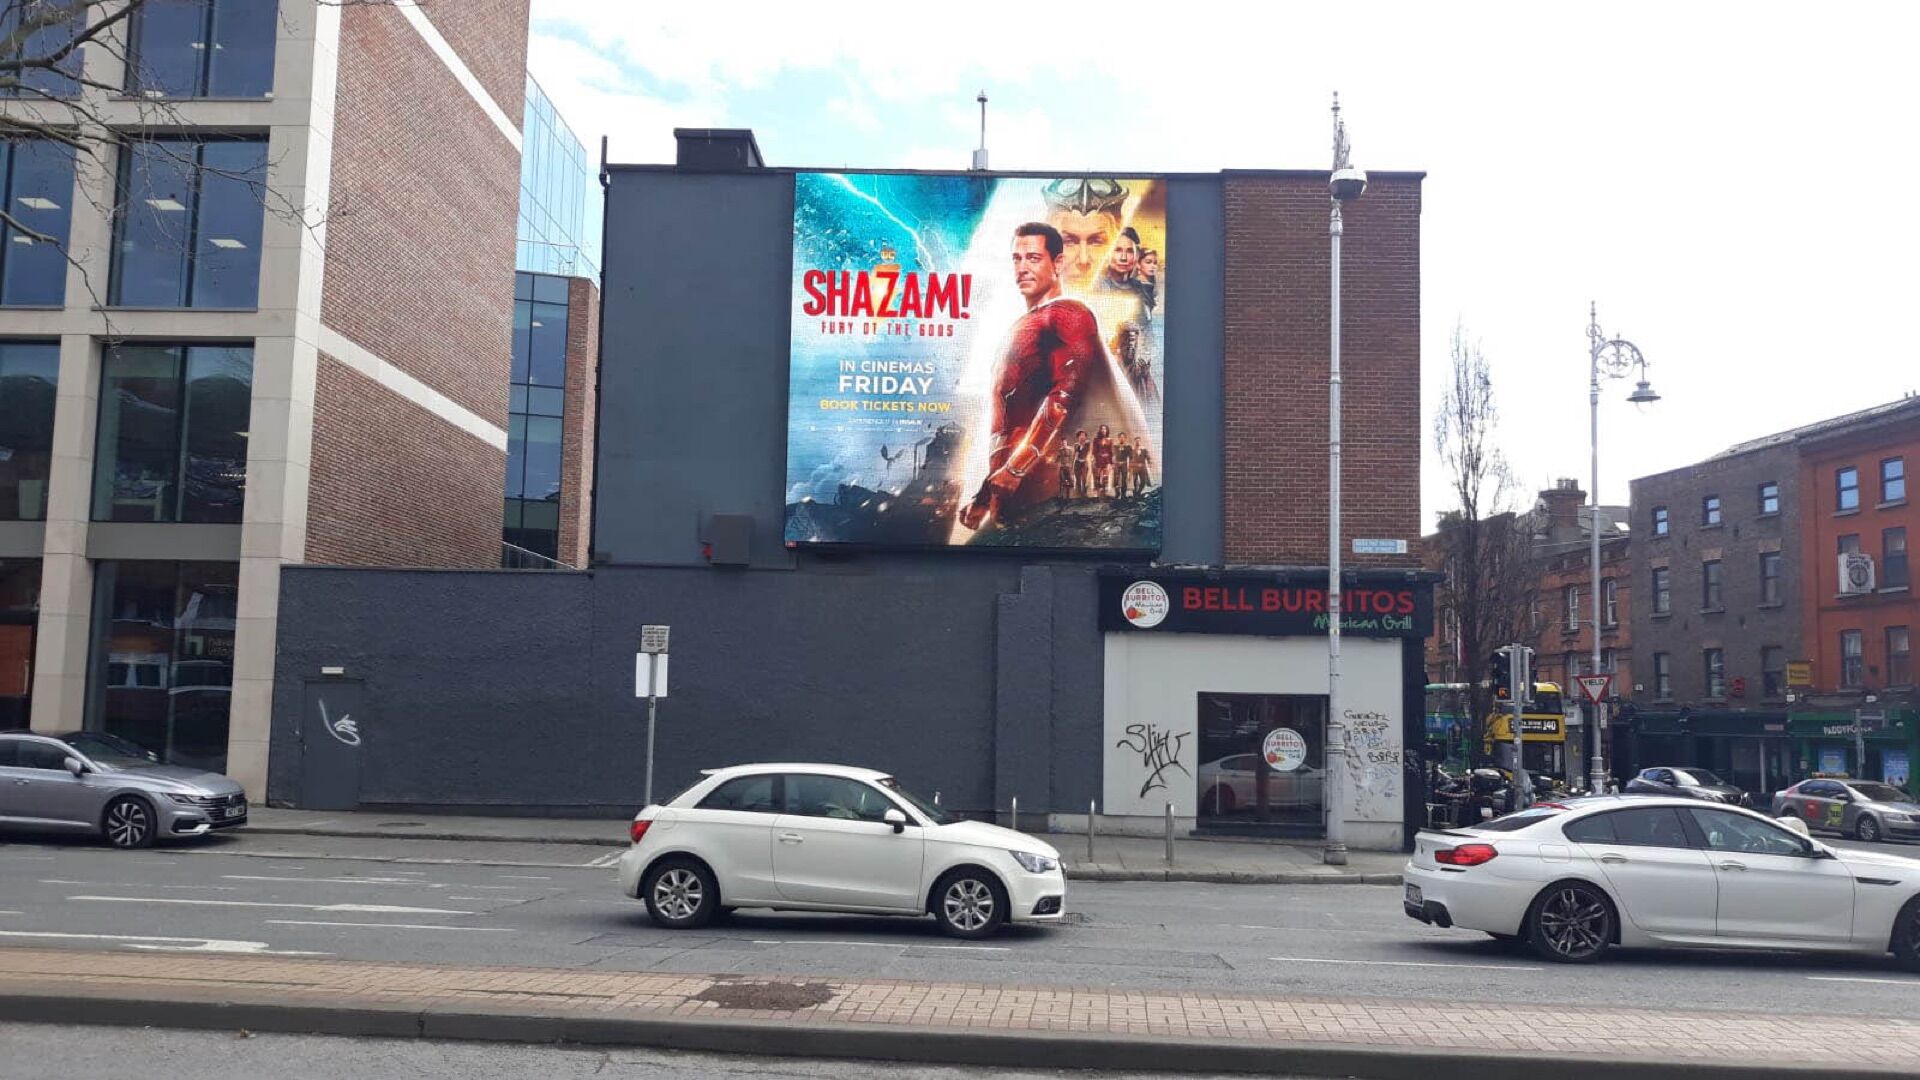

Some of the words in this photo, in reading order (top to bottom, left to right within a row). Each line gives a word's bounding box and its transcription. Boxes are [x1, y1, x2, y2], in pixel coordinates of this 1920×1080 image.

[803, 269, 972, 320] SHAZAM!
[821, 321, 853, 334] FURY
[887, 323, 911, 336] THE
[919, 324, 953, 336] GODS
[840, 360, 855, 372] IN
[861, 361, 934, 374] CINEMAS
[839, 375, 934, 395] FRIDAY
[820, 399, 858, 410] BOOK
[863, 401, 914, 412] TICKETS
[918, 402, 951, 413] NOW
[1135, 587, 1154, 595] BELL
[1183, 587, 1254, 611] BELL
[1314, 614, 1378, 629] Mxican
[1382, 615, 1412, 630] Grill
[1583, 678, 1604, 686] YIELD
[1543, 720, 1556, 730] 140
